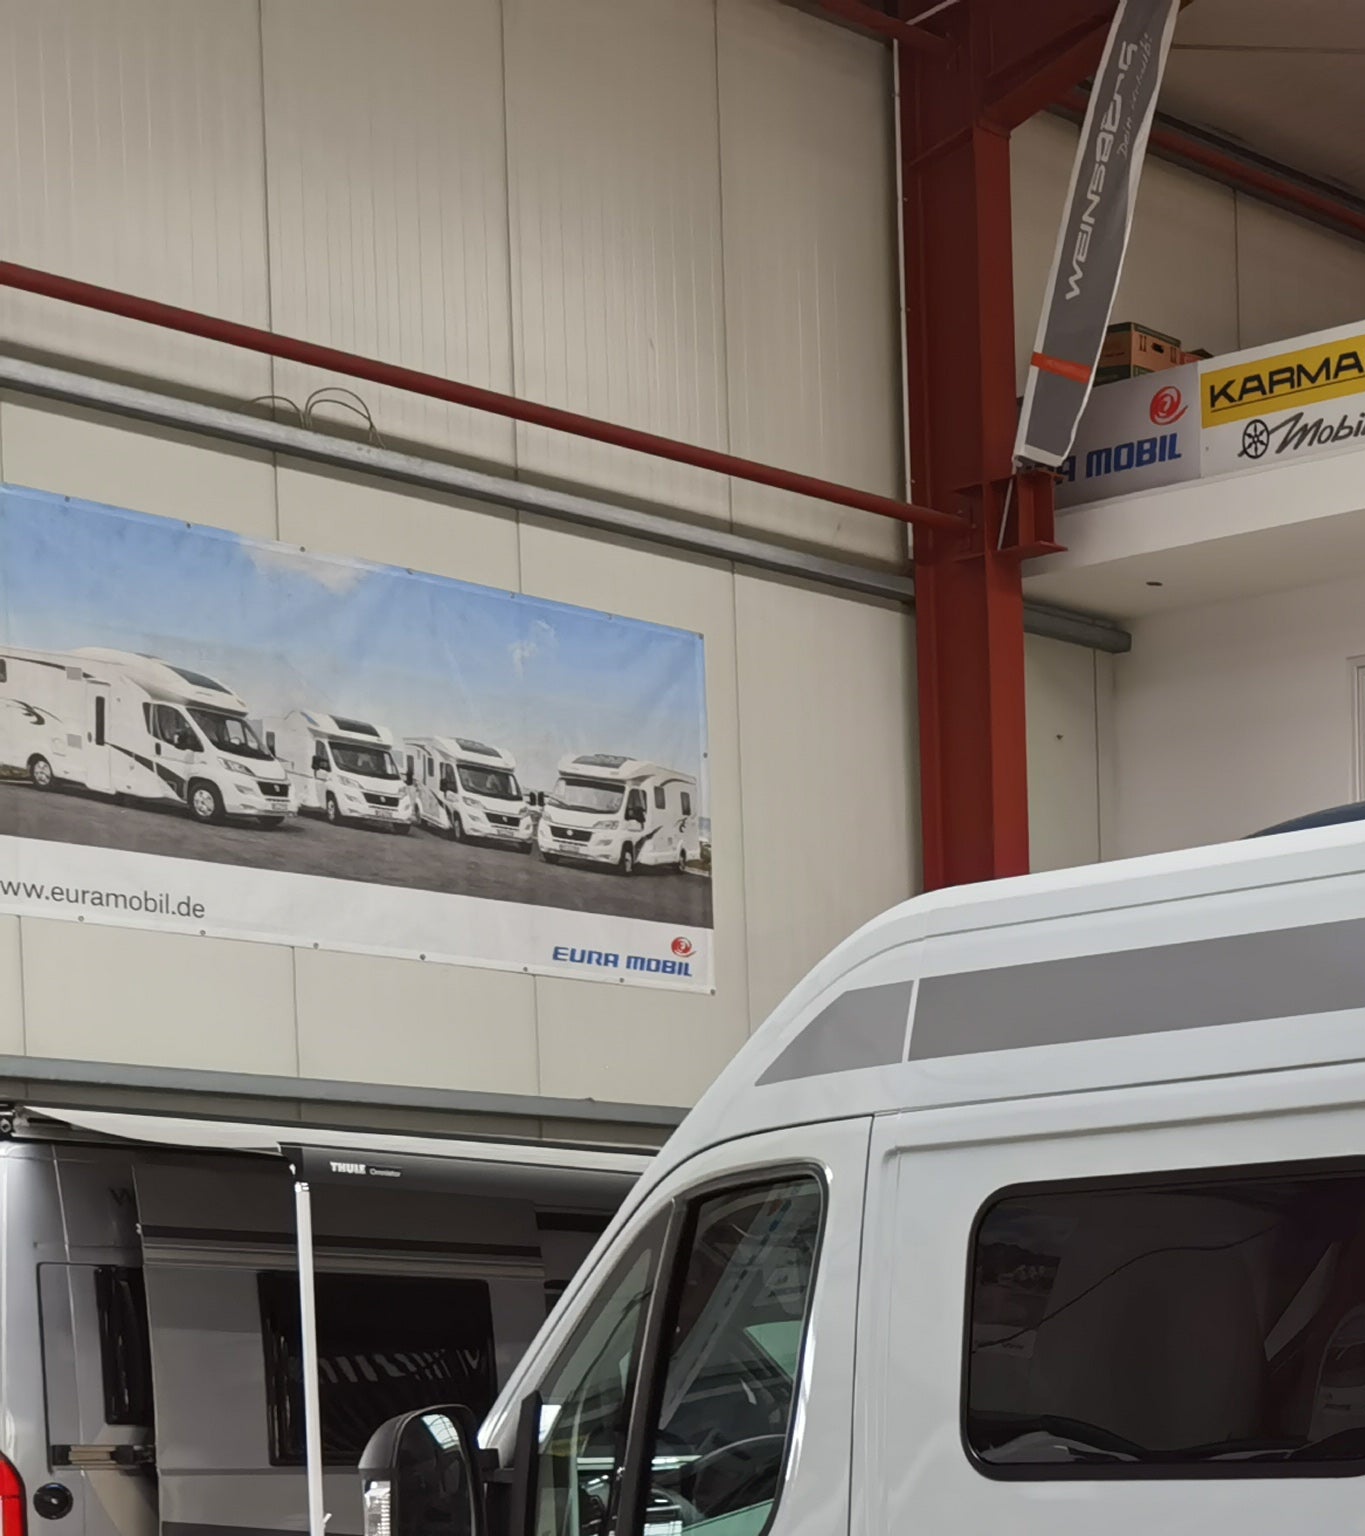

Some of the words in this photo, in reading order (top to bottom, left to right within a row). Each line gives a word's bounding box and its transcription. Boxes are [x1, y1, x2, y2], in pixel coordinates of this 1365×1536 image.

[1086, 433, 1182, 479] MOBIL
[552, 945, 619, 968] EURA
[625, 955, 692, 977] MOBIL
[329, 1161, 366, 1174] THULE
